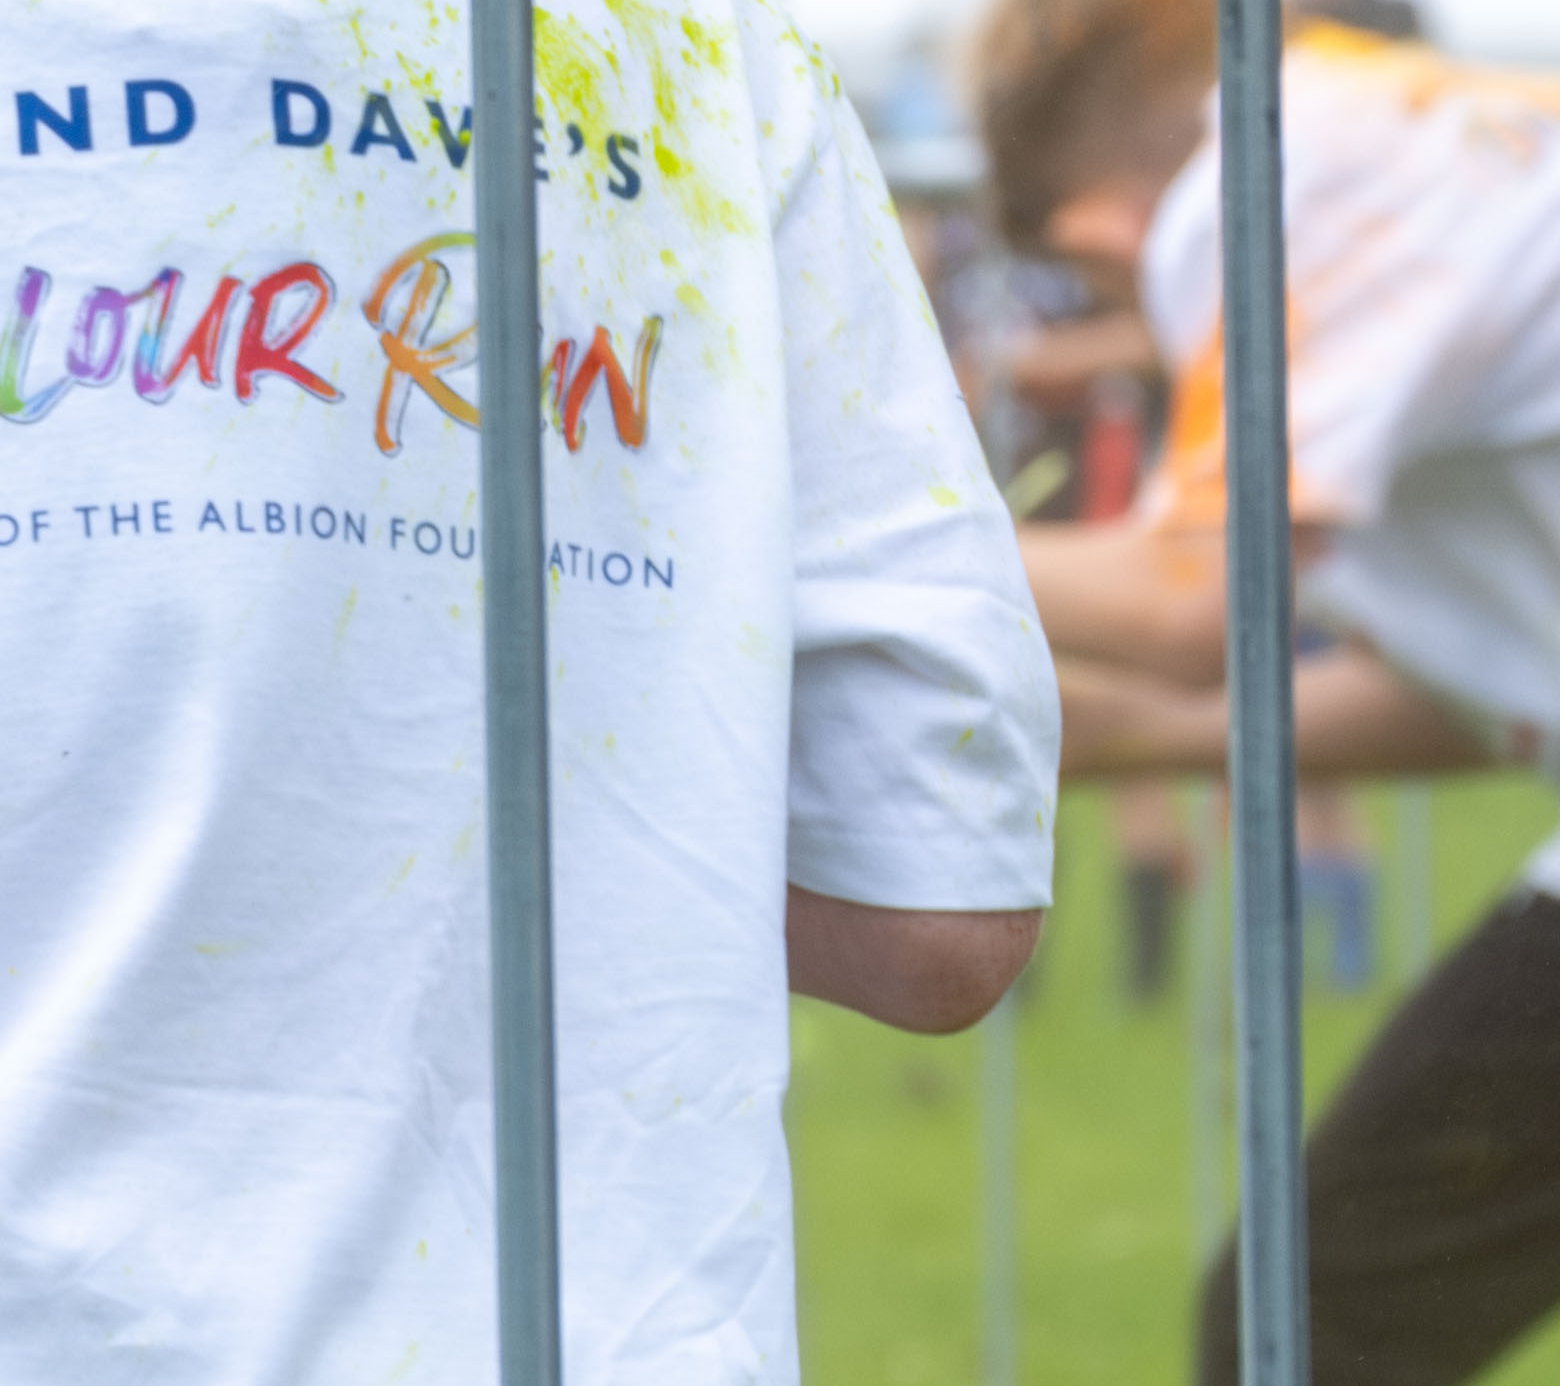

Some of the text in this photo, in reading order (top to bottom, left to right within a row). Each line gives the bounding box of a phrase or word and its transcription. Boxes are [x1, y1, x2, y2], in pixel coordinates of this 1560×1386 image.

[73, 500, 174, 539] THE
[197, 499, 368, 547] ALBION
[388, 516, 675, 590] FOUATION
